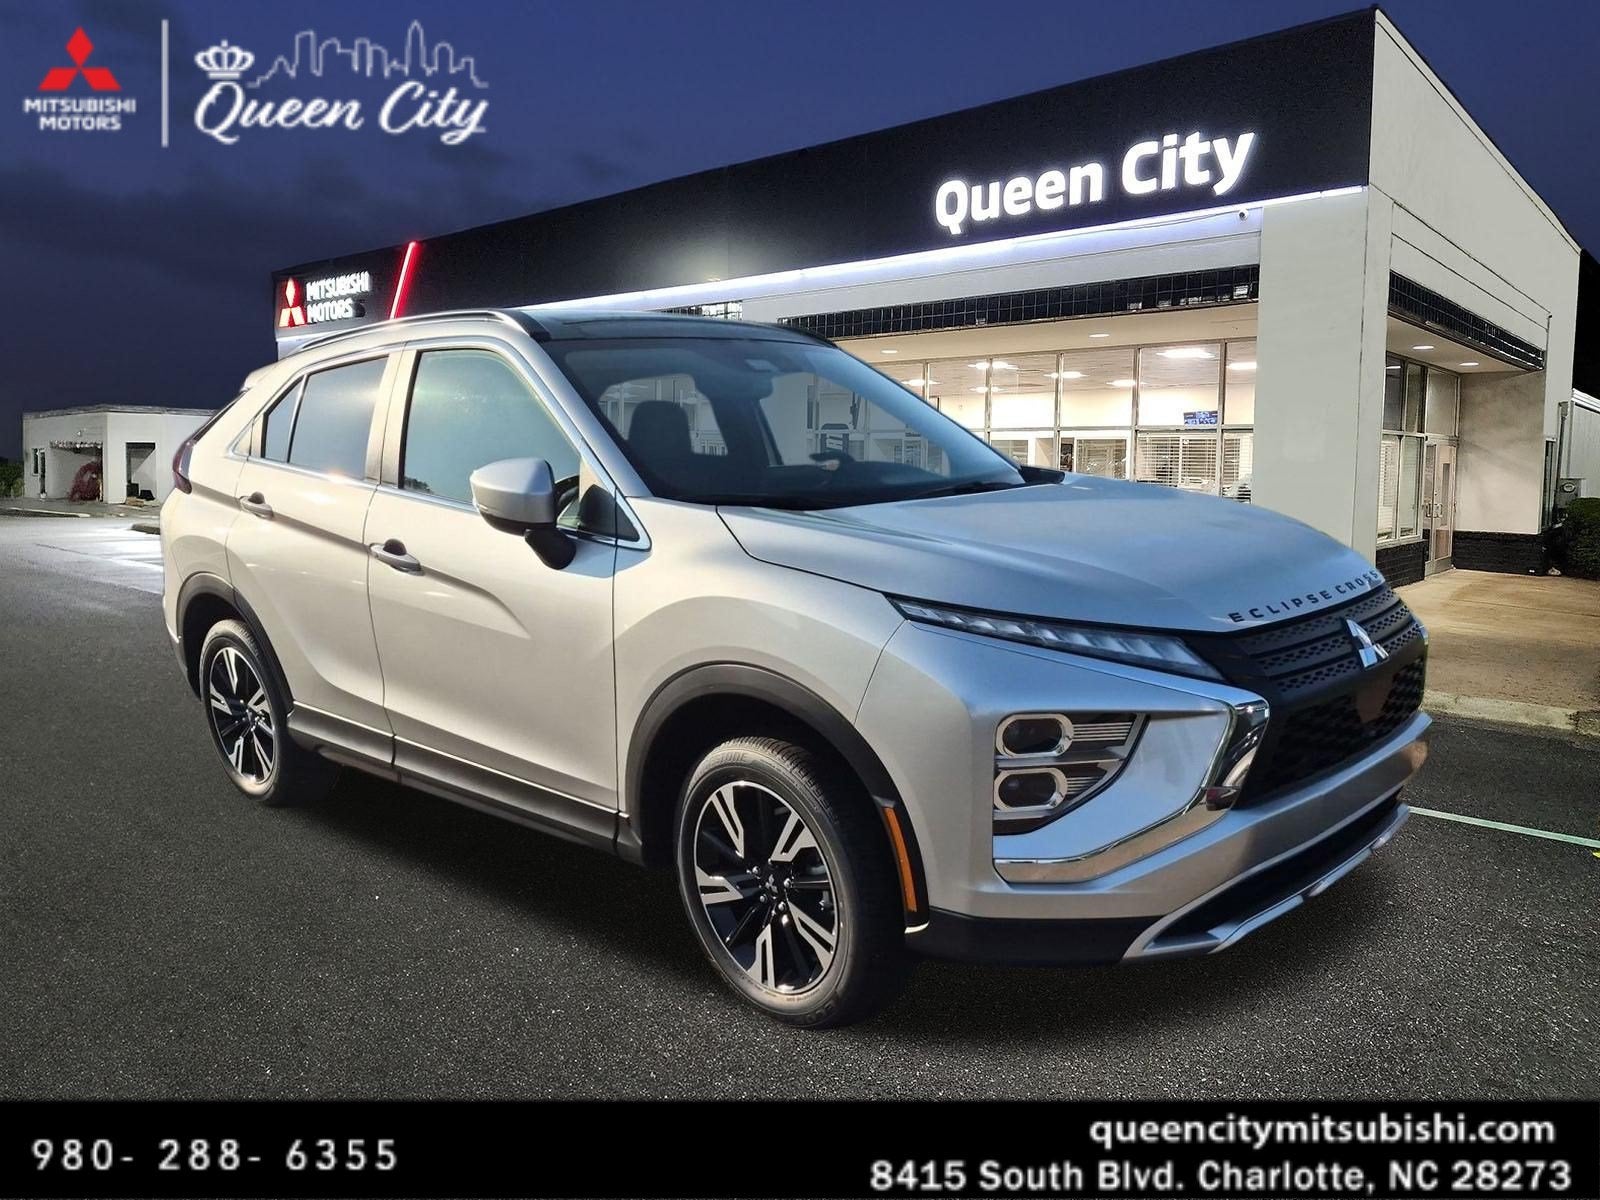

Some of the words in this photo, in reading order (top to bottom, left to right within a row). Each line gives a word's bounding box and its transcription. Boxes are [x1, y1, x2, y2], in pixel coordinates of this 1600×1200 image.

[935, 161, 1104, 235] Queen
[1121, 131, 1255, 196] City
[306, 271, 370, 301] MITSUBISHI
[306, 298, 354, 323] MOTORS
[1228, 590, 1333, 623] ECLIPSE
[1335, 569, 1379, 594] CROSS
